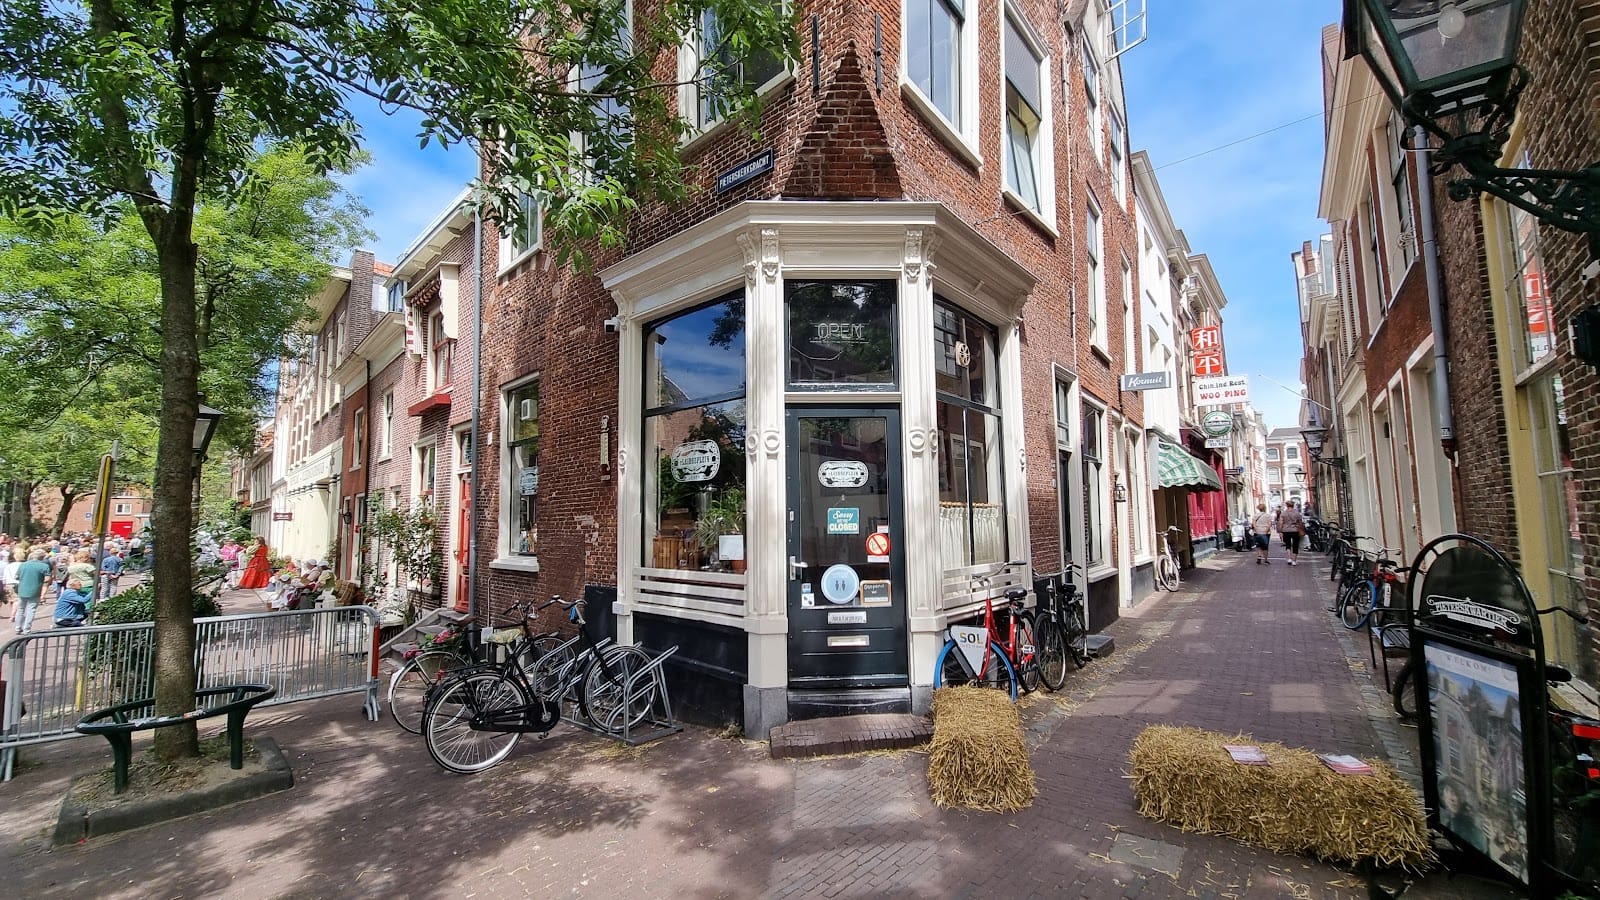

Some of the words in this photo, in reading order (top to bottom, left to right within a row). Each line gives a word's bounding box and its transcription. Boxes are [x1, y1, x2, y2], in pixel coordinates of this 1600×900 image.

[817, 323, 863, 339] OPEN
[1200, 392, 1220, 400] WOO
[1225, 389, 1246, 397] PING
[832, 510, 854, 521] Sorry
[829, 523, 858, 532] CLOSED
[960, 633, 984, 644] SOL
